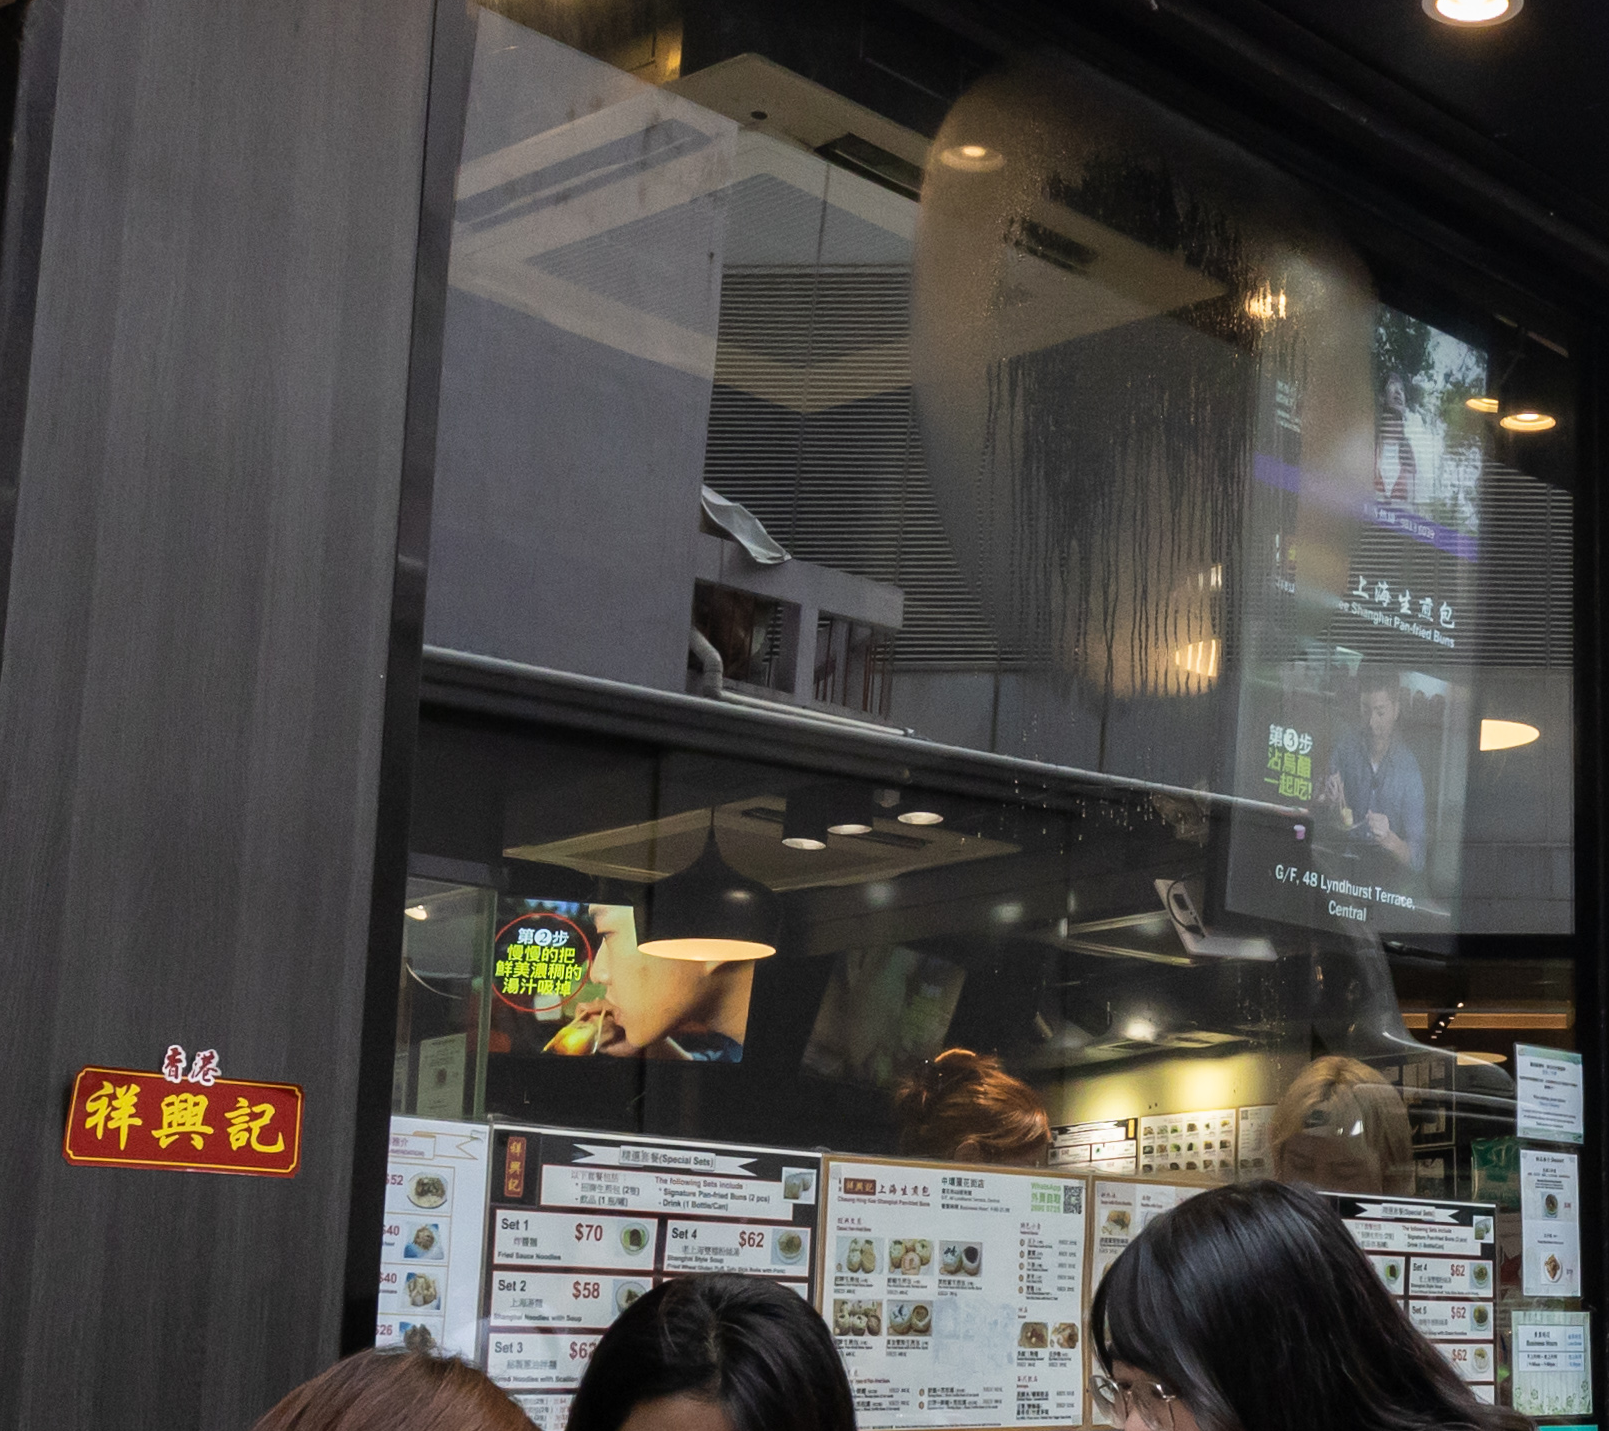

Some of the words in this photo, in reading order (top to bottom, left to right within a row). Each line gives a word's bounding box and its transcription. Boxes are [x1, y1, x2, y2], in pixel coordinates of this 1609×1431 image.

[1351, 601, 1392, 627] Shanghai
[1433, 632, 1455, 649] Buns
[1302, 870, 1318, 888] 48
[1320, 874, 1372, 900] Lyndhurst
[1375, 886, 1416, 910] Terrace,
[1328, 900, 1367, 922] Central
[506, 944, 576, 964] 慢慢的把
[162, 1045, 221, 1085] 香港
[85, 1080, 286, 1154] 祥興記
[501, 1217, 522, 1231] Set
[574, 1222, 604, 1243] $70
[671, 1227, 690, 1240] Set
[738, 1230, 765, 1249] $62
[1413, 1262, 1423, 1271] Set
[1450, 1263, 1466, 1277] $62
[497, 1279, 519, 1292] Set
[572, 1280, 601, 1300] $58
[1412, 1305, 1422, 1314] Set
[1451, 1305, 1467, 1319] $62
[494, 1341, 515, 1354] Set
[1452, 1348, 1468, 1362] $62
